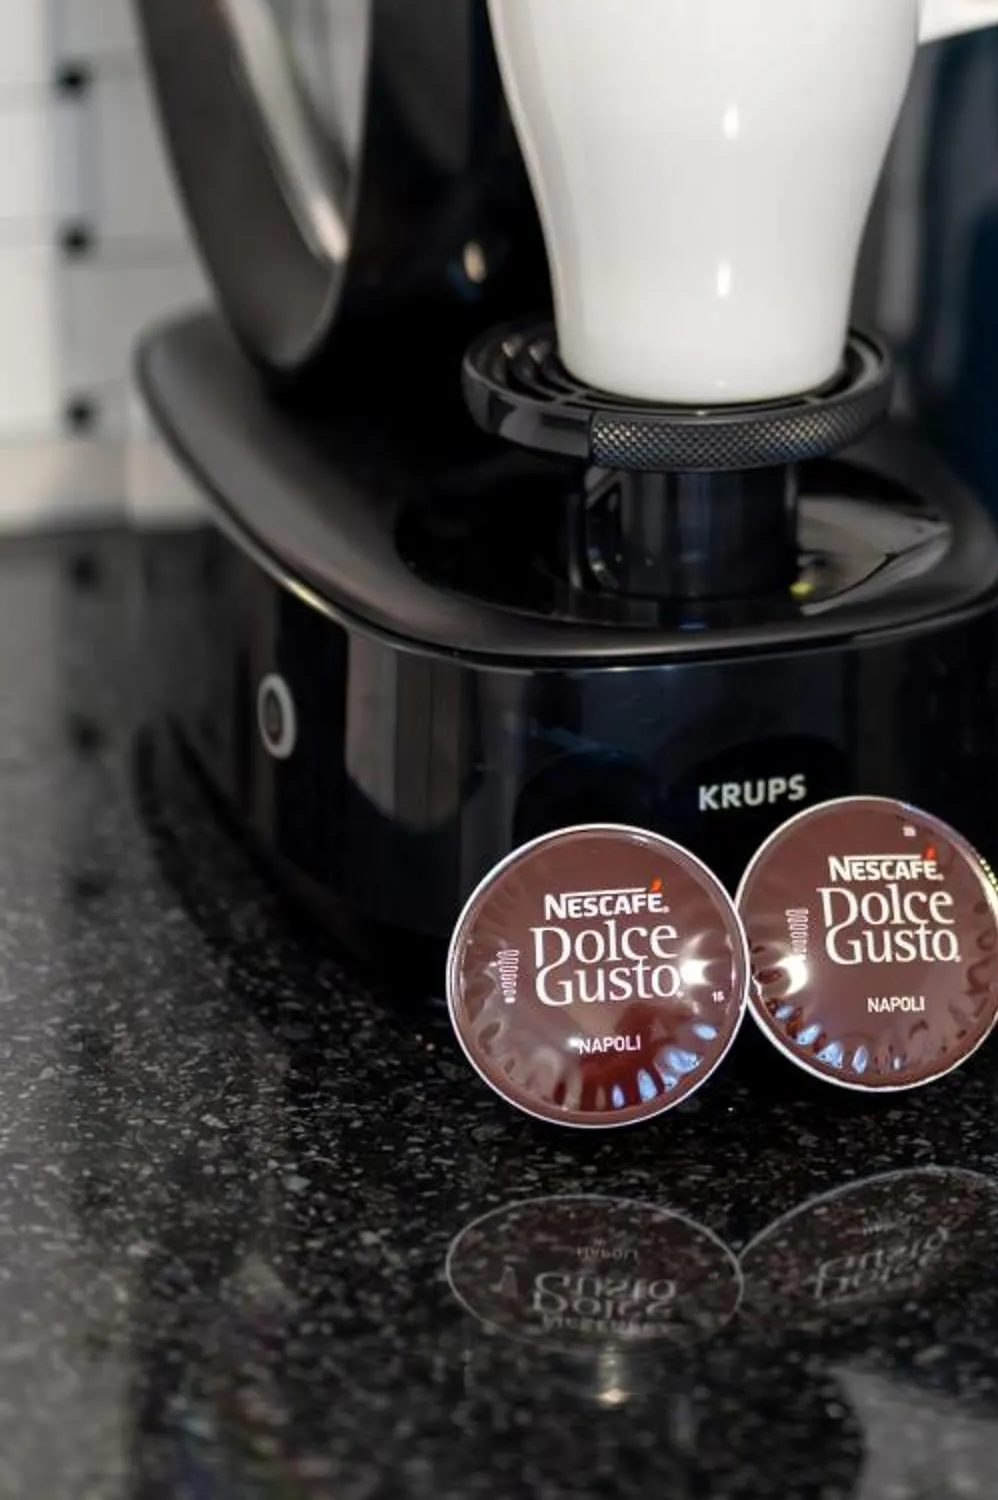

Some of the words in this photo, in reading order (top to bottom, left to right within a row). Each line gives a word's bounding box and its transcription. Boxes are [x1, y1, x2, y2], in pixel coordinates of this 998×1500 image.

[698, 773, 807, 811] KRUPS
[816, 883, 956, 928] Dolce
[529, 919, 680, 969] Dolce
[825, 924, 959, 965] Gusto
[535, 958, 682, 1006] Gusto
[867, 996, 925, 1013] NAPOLI
[578, 1034, 641, 1055] NAPOLI
